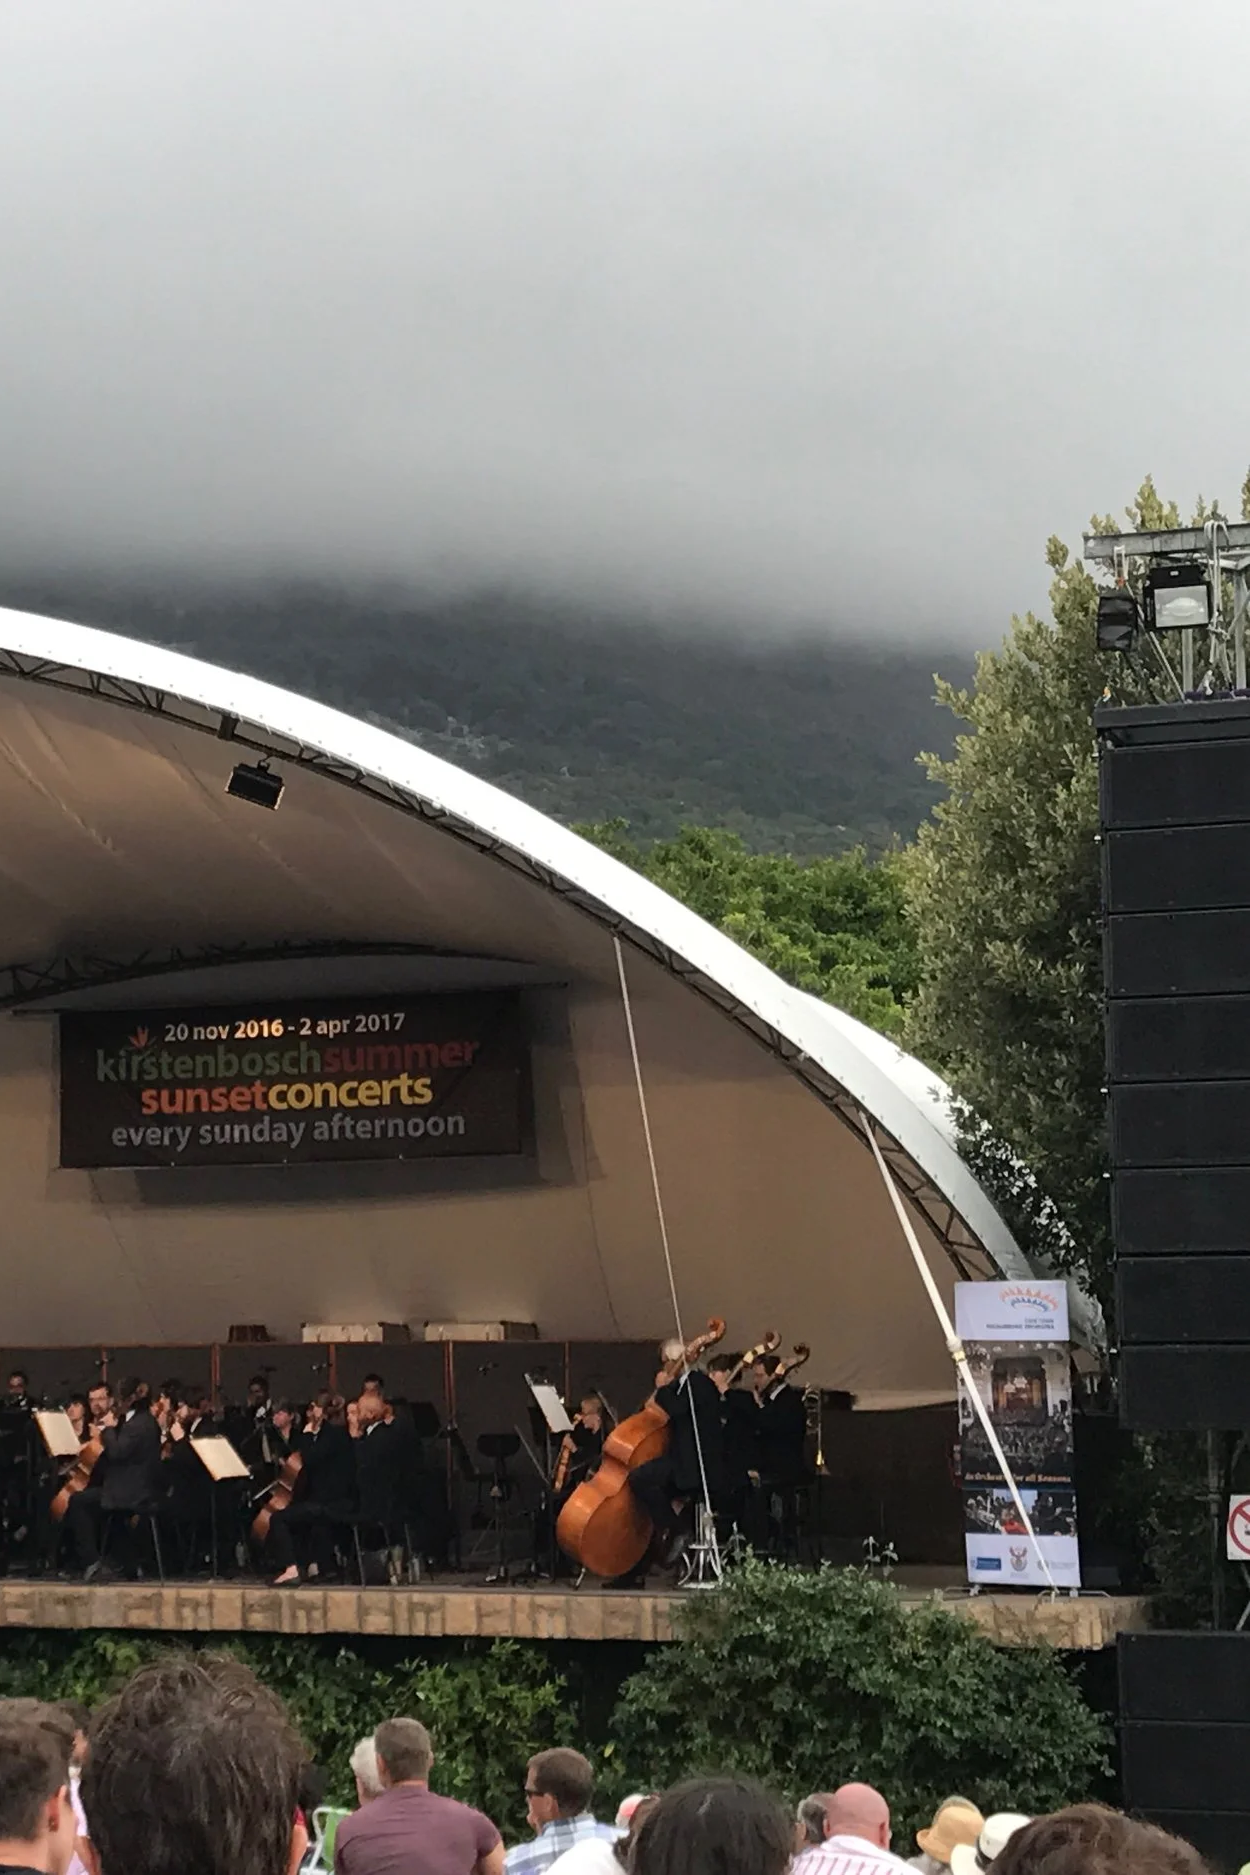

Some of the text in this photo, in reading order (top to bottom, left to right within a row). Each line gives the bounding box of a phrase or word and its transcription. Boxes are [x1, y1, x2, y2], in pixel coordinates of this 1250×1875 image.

[164, 1023, 188, 1042] 20
[193, 1024, 229, 1041] nov
[234, 1019, 284, 1039] 2016
[299, 1017, 312, 1036] 2
[316, 1018, 350, 1040] apr
[355, 1013, 406, 1033] 2017
[112, 1112, 466, 1152] every sunday afternoon
